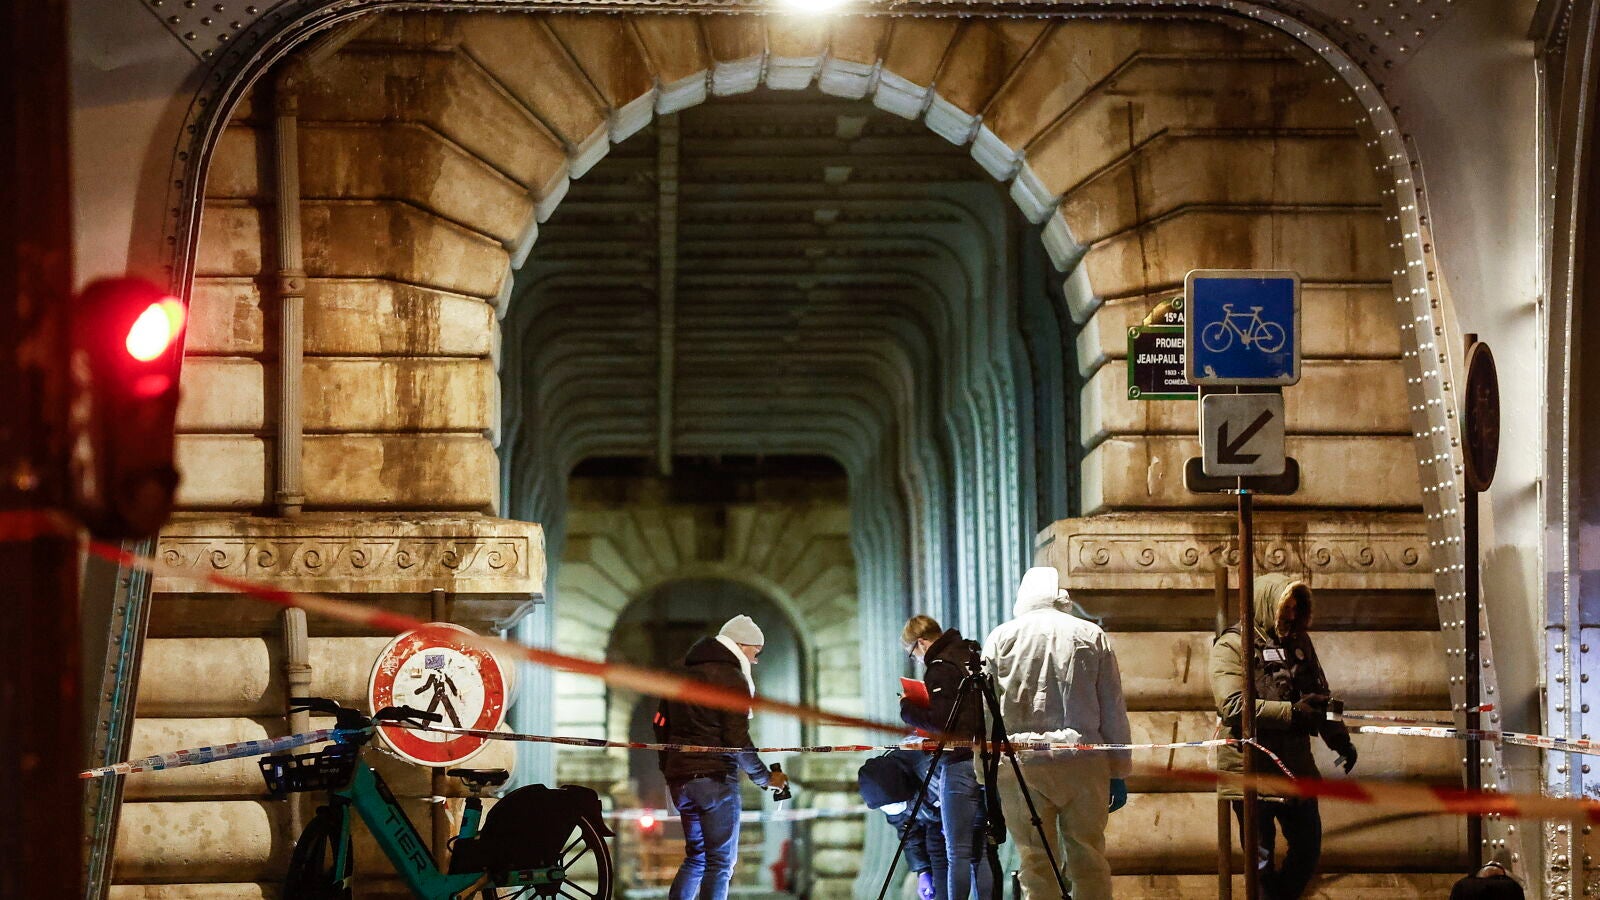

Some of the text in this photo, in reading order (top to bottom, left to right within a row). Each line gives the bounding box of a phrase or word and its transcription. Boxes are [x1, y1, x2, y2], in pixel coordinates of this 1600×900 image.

[1178, 312, 1185, 322] A
[1155, 337, 1185, 348] PROMEN
[1137, 354, 1178, 364] JEAN-PAUL
[385, 805, 427, 875] TIER
